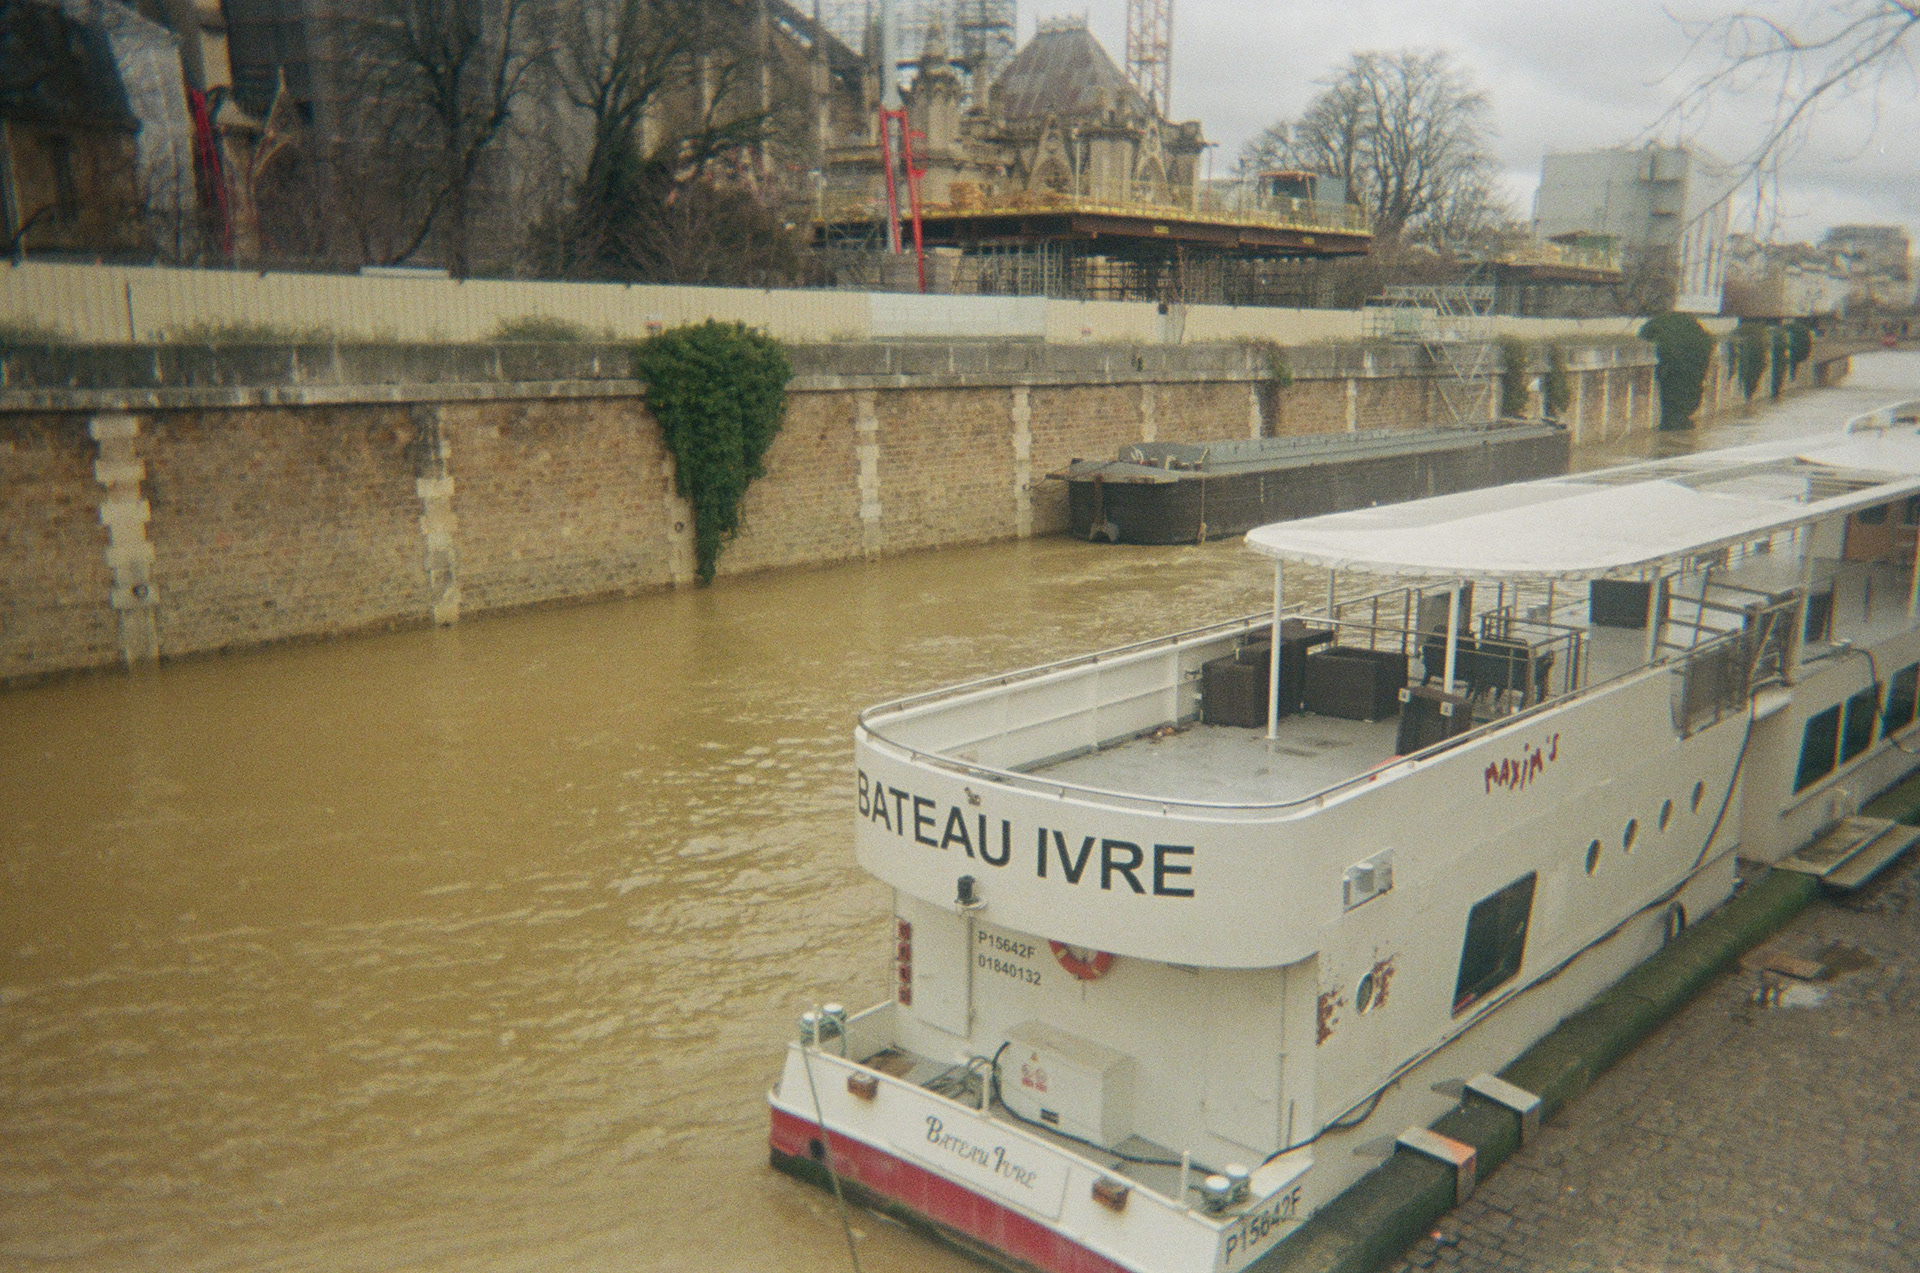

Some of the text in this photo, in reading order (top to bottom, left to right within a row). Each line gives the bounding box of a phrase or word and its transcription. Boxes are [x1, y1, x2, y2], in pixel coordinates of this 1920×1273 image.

[858, 768, 1195, 898] BATEAU IVRE
[978, 930, 1036, 959] P15642F
[978, 953, 1041, 986] 01840132
